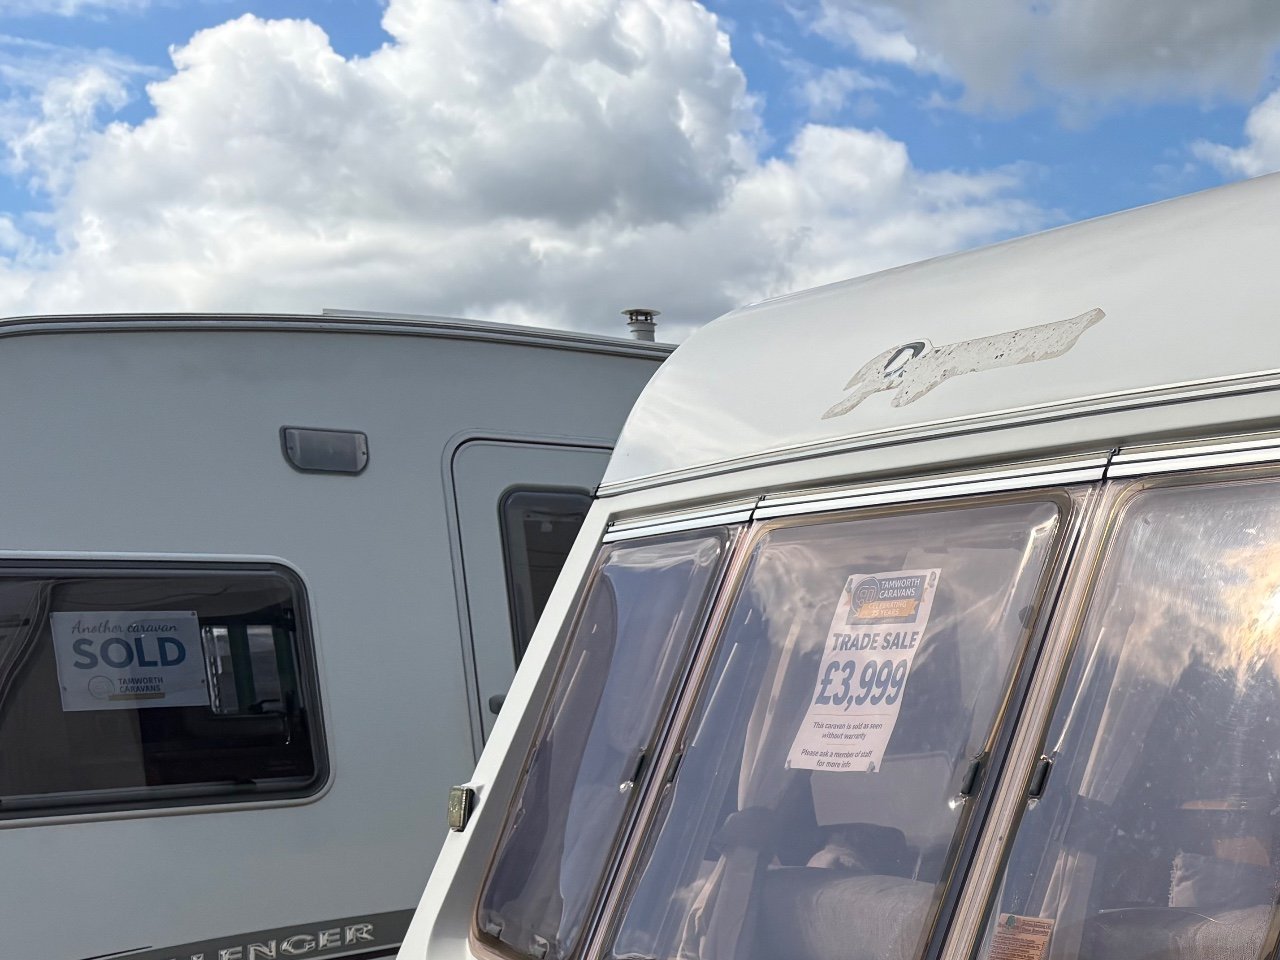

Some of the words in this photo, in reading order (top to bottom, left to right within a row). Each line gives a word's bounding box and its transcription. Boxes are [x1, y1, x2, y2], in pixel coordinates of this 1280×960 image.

[881, 578, 920, 590] TAMWORTH
[880, 587, 916, 599] CARAVANS
[71, 620, 124, 634] Another
[127, 624, 178, 634] caravan
[832, 632, 881, 651] TRADE
[881, 631, 920, 651] SALE
[72, 636, 187, 670] SOLD
[118, 676, 164, 686] TAMWORTH
[815, 659, 908, 712] £3,999
[119, 684, 161, 693] CARAVANS
[813, 721, 825, 729] This
[852, 722, 863, 730] sold
[844, 733, 866, 741] warranty
[801, 748, 819, 757] Please
[860, 750, 873, 758] staff
[816, 759, 825, 767] for
[841, 760, 851, 768] info
